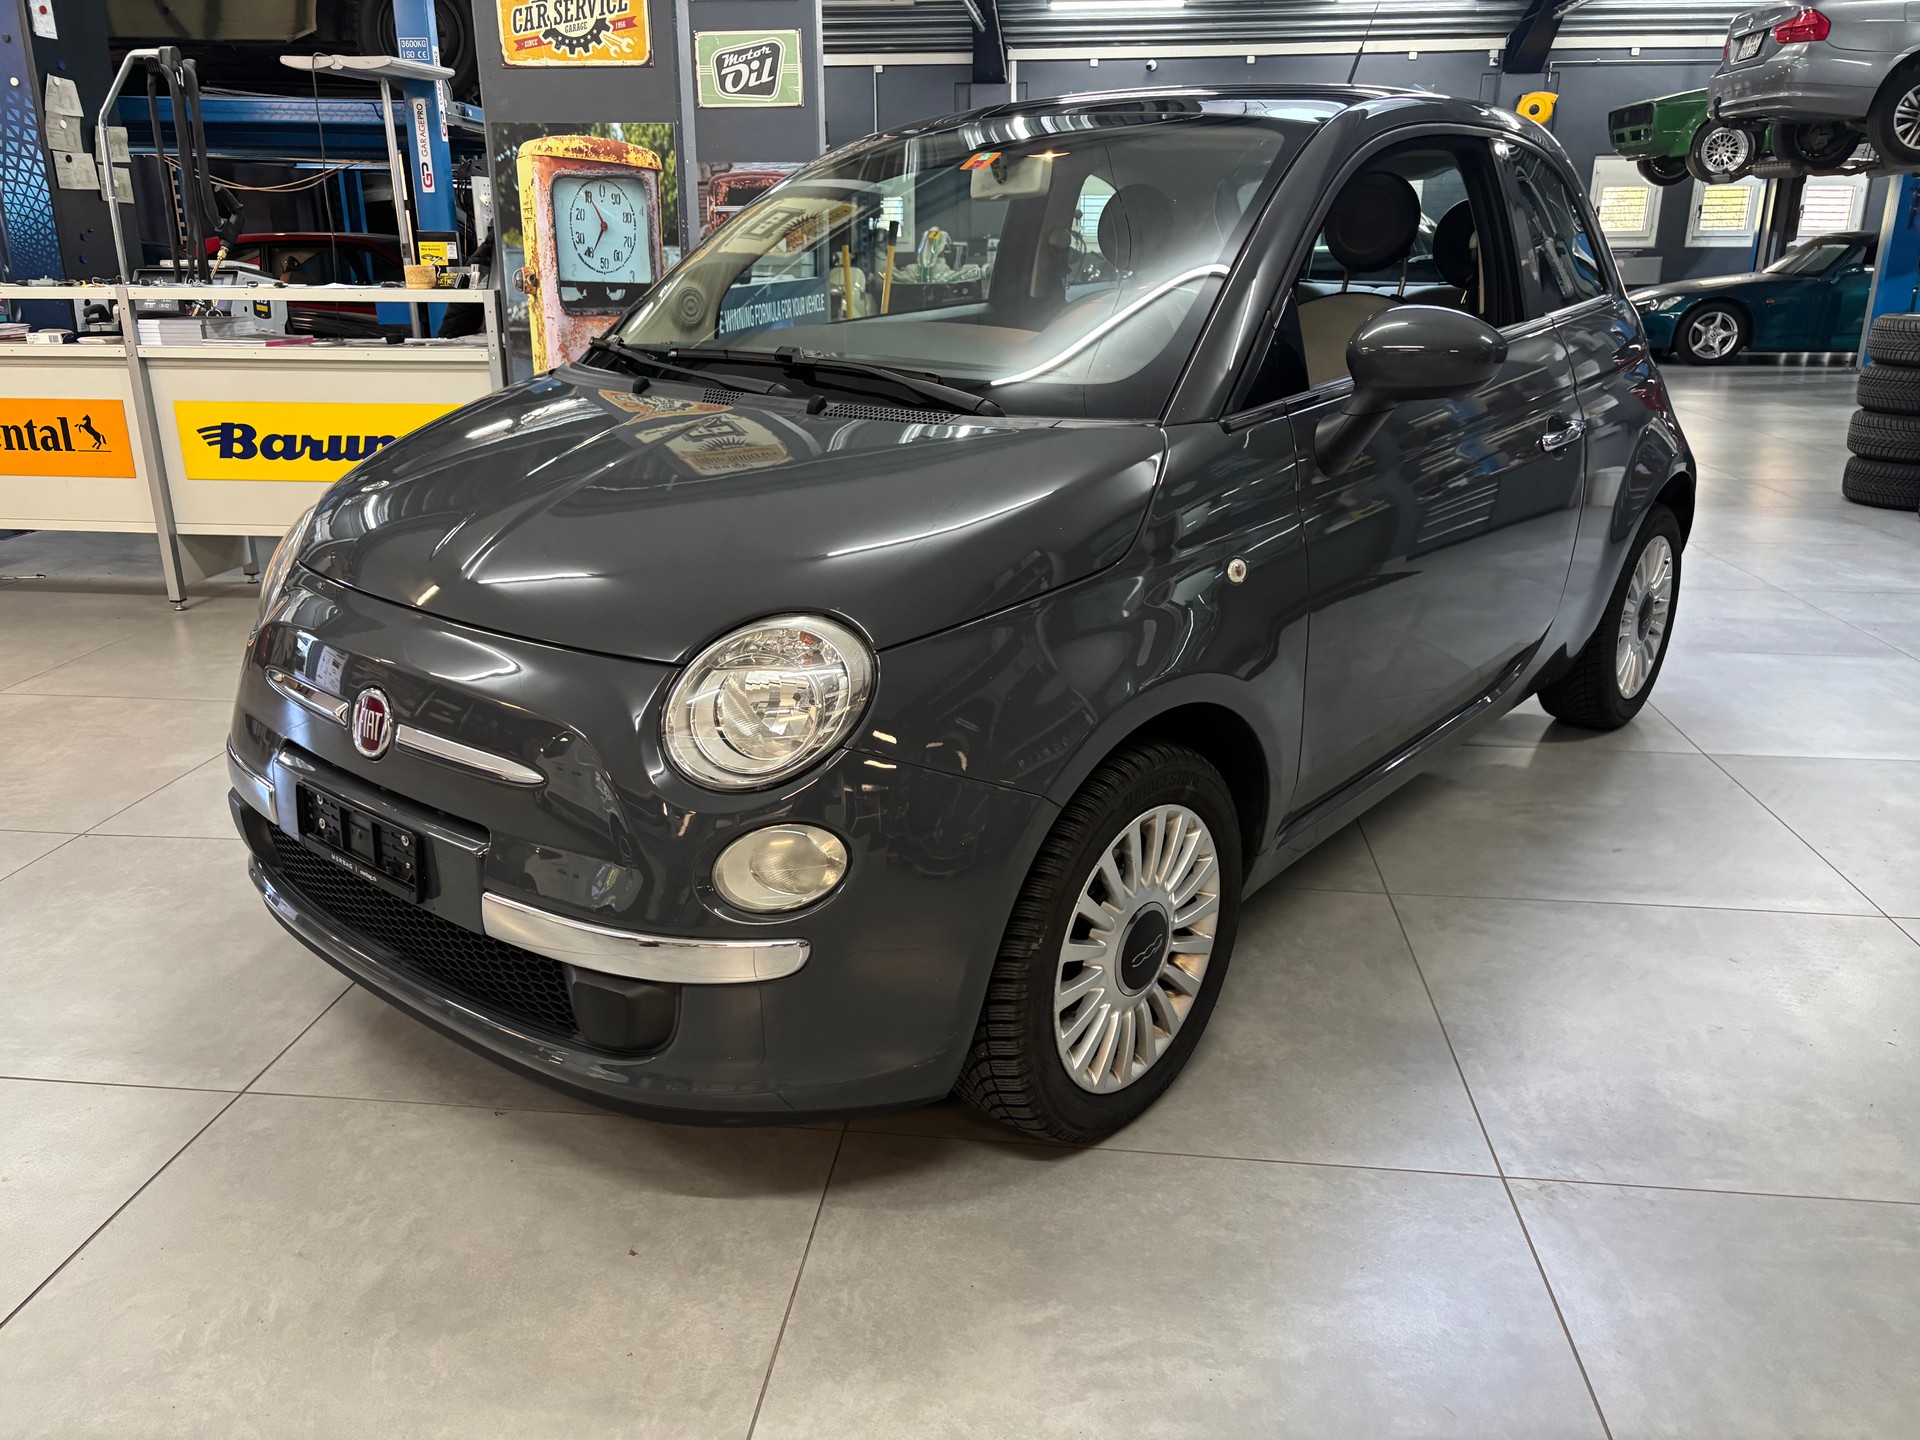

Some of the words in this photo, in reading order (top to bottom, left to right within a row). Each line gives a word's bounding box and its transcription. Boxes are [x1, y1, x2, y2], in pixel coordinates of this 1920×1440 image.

[512, 4, 549, 34] CAR
[564, 21, 588, 33] GARAGE
[402, 51, 415, 59] ISO
[721, 45, 771, 68] Motor
[720, 57, 775, 93] Oil
[416, 103, 429, 157] GARAGEPRO
[611, 193, 621, 205] 90
[575, 207, 586, 221] 20
[622, 212, 633, 224] 80
[575, 231, 586, 245] 30
[623, 235, 633, 249] 70
[613, 249, 624, 262] 60
[600, 256, 610, 270] 50
[724, 304, 755, 333] WINNING
[755, 300, 781, 326] FORMULA
[781, 298, 793, 320] FOR
[791, 297, 806, 318] YOUR
[805, 293, 826, 314] VEHICLE
[0, 416, 77, 452] ntal
[358, 706, 383, 742] FIAT
